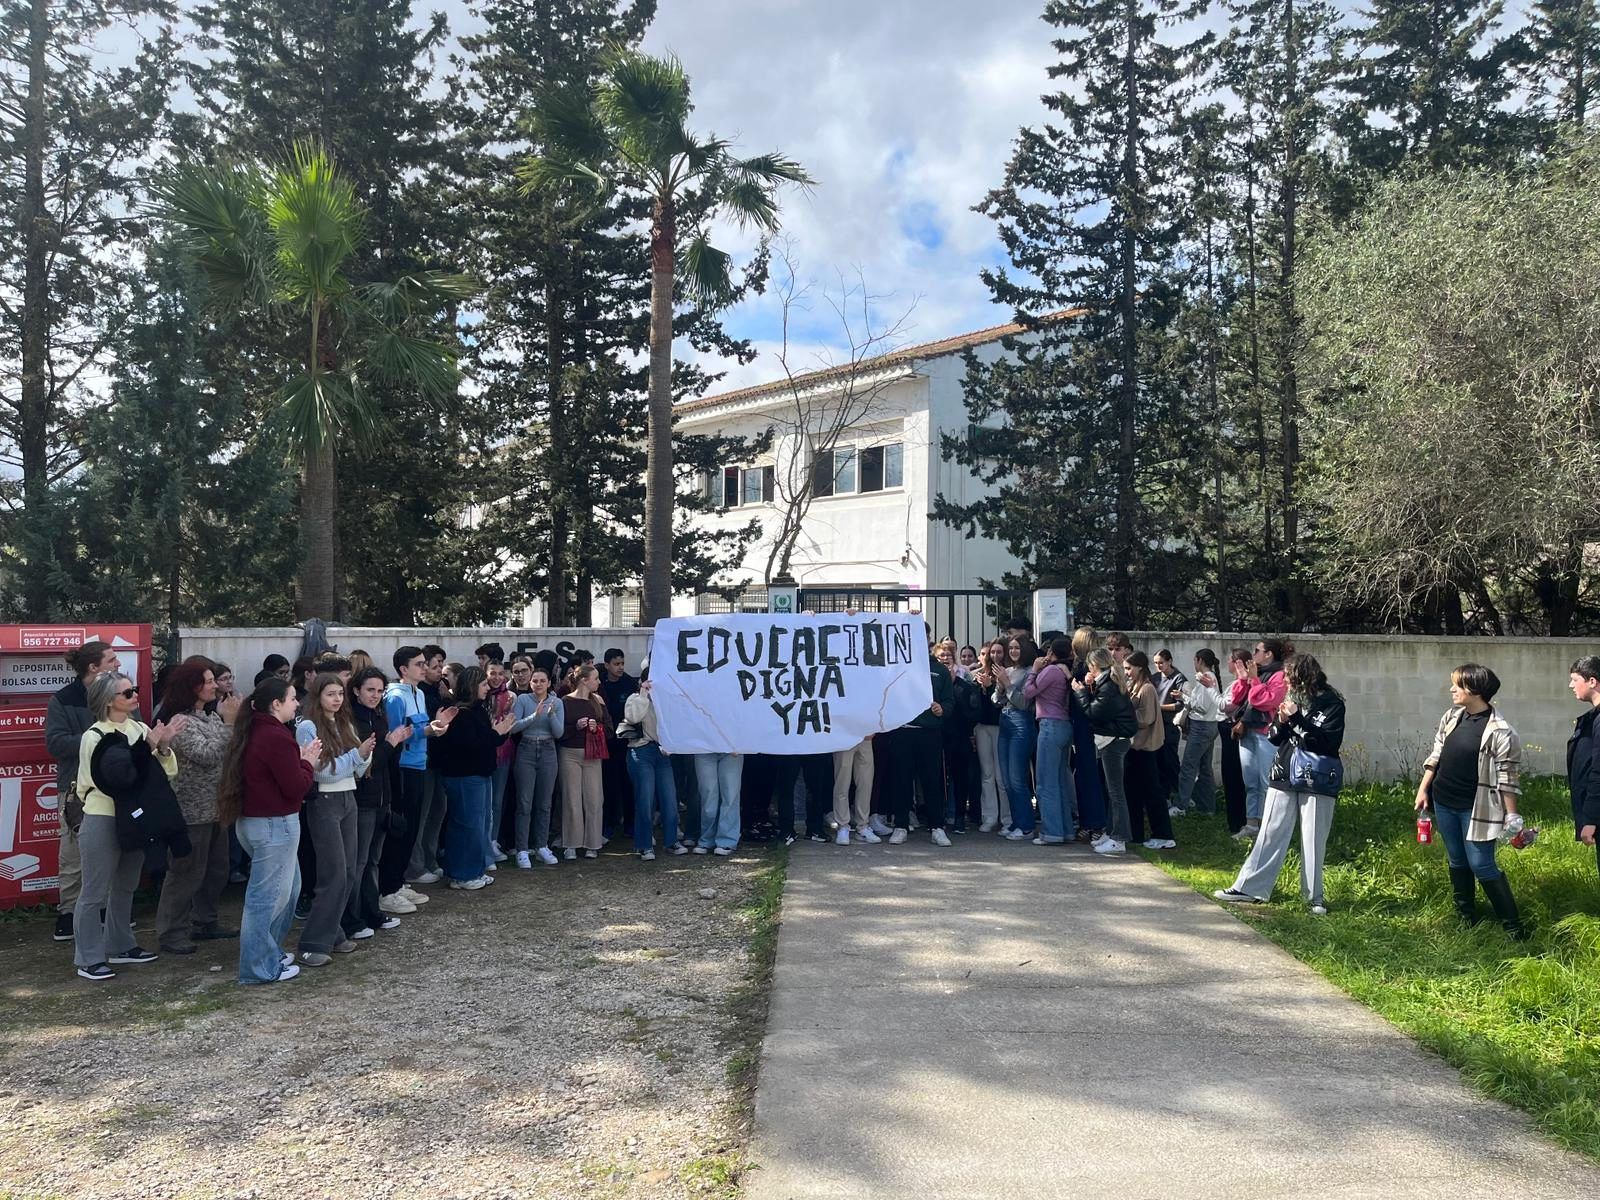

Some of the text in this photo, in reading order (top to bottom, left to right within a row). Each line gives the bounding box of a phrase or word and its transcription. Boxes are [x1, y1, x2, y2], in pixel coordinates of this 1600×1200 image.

[23, 637, 81, 646] 956 727 946
[677, 618, 912, 673] EDUCACIÓN
[12, 663, 64, 673] DEPOSITAR
[2, 676, 76, 687] BOLSAS CERRAD
[737, 666, 845, 701] DIGNA
[0, 715, 46, 726] ue tu rop
[770, 700, 831, 736] YA!
[0, 763, 58, 776] ATOS Y R
[33, 812, 58, 822] ARCG
